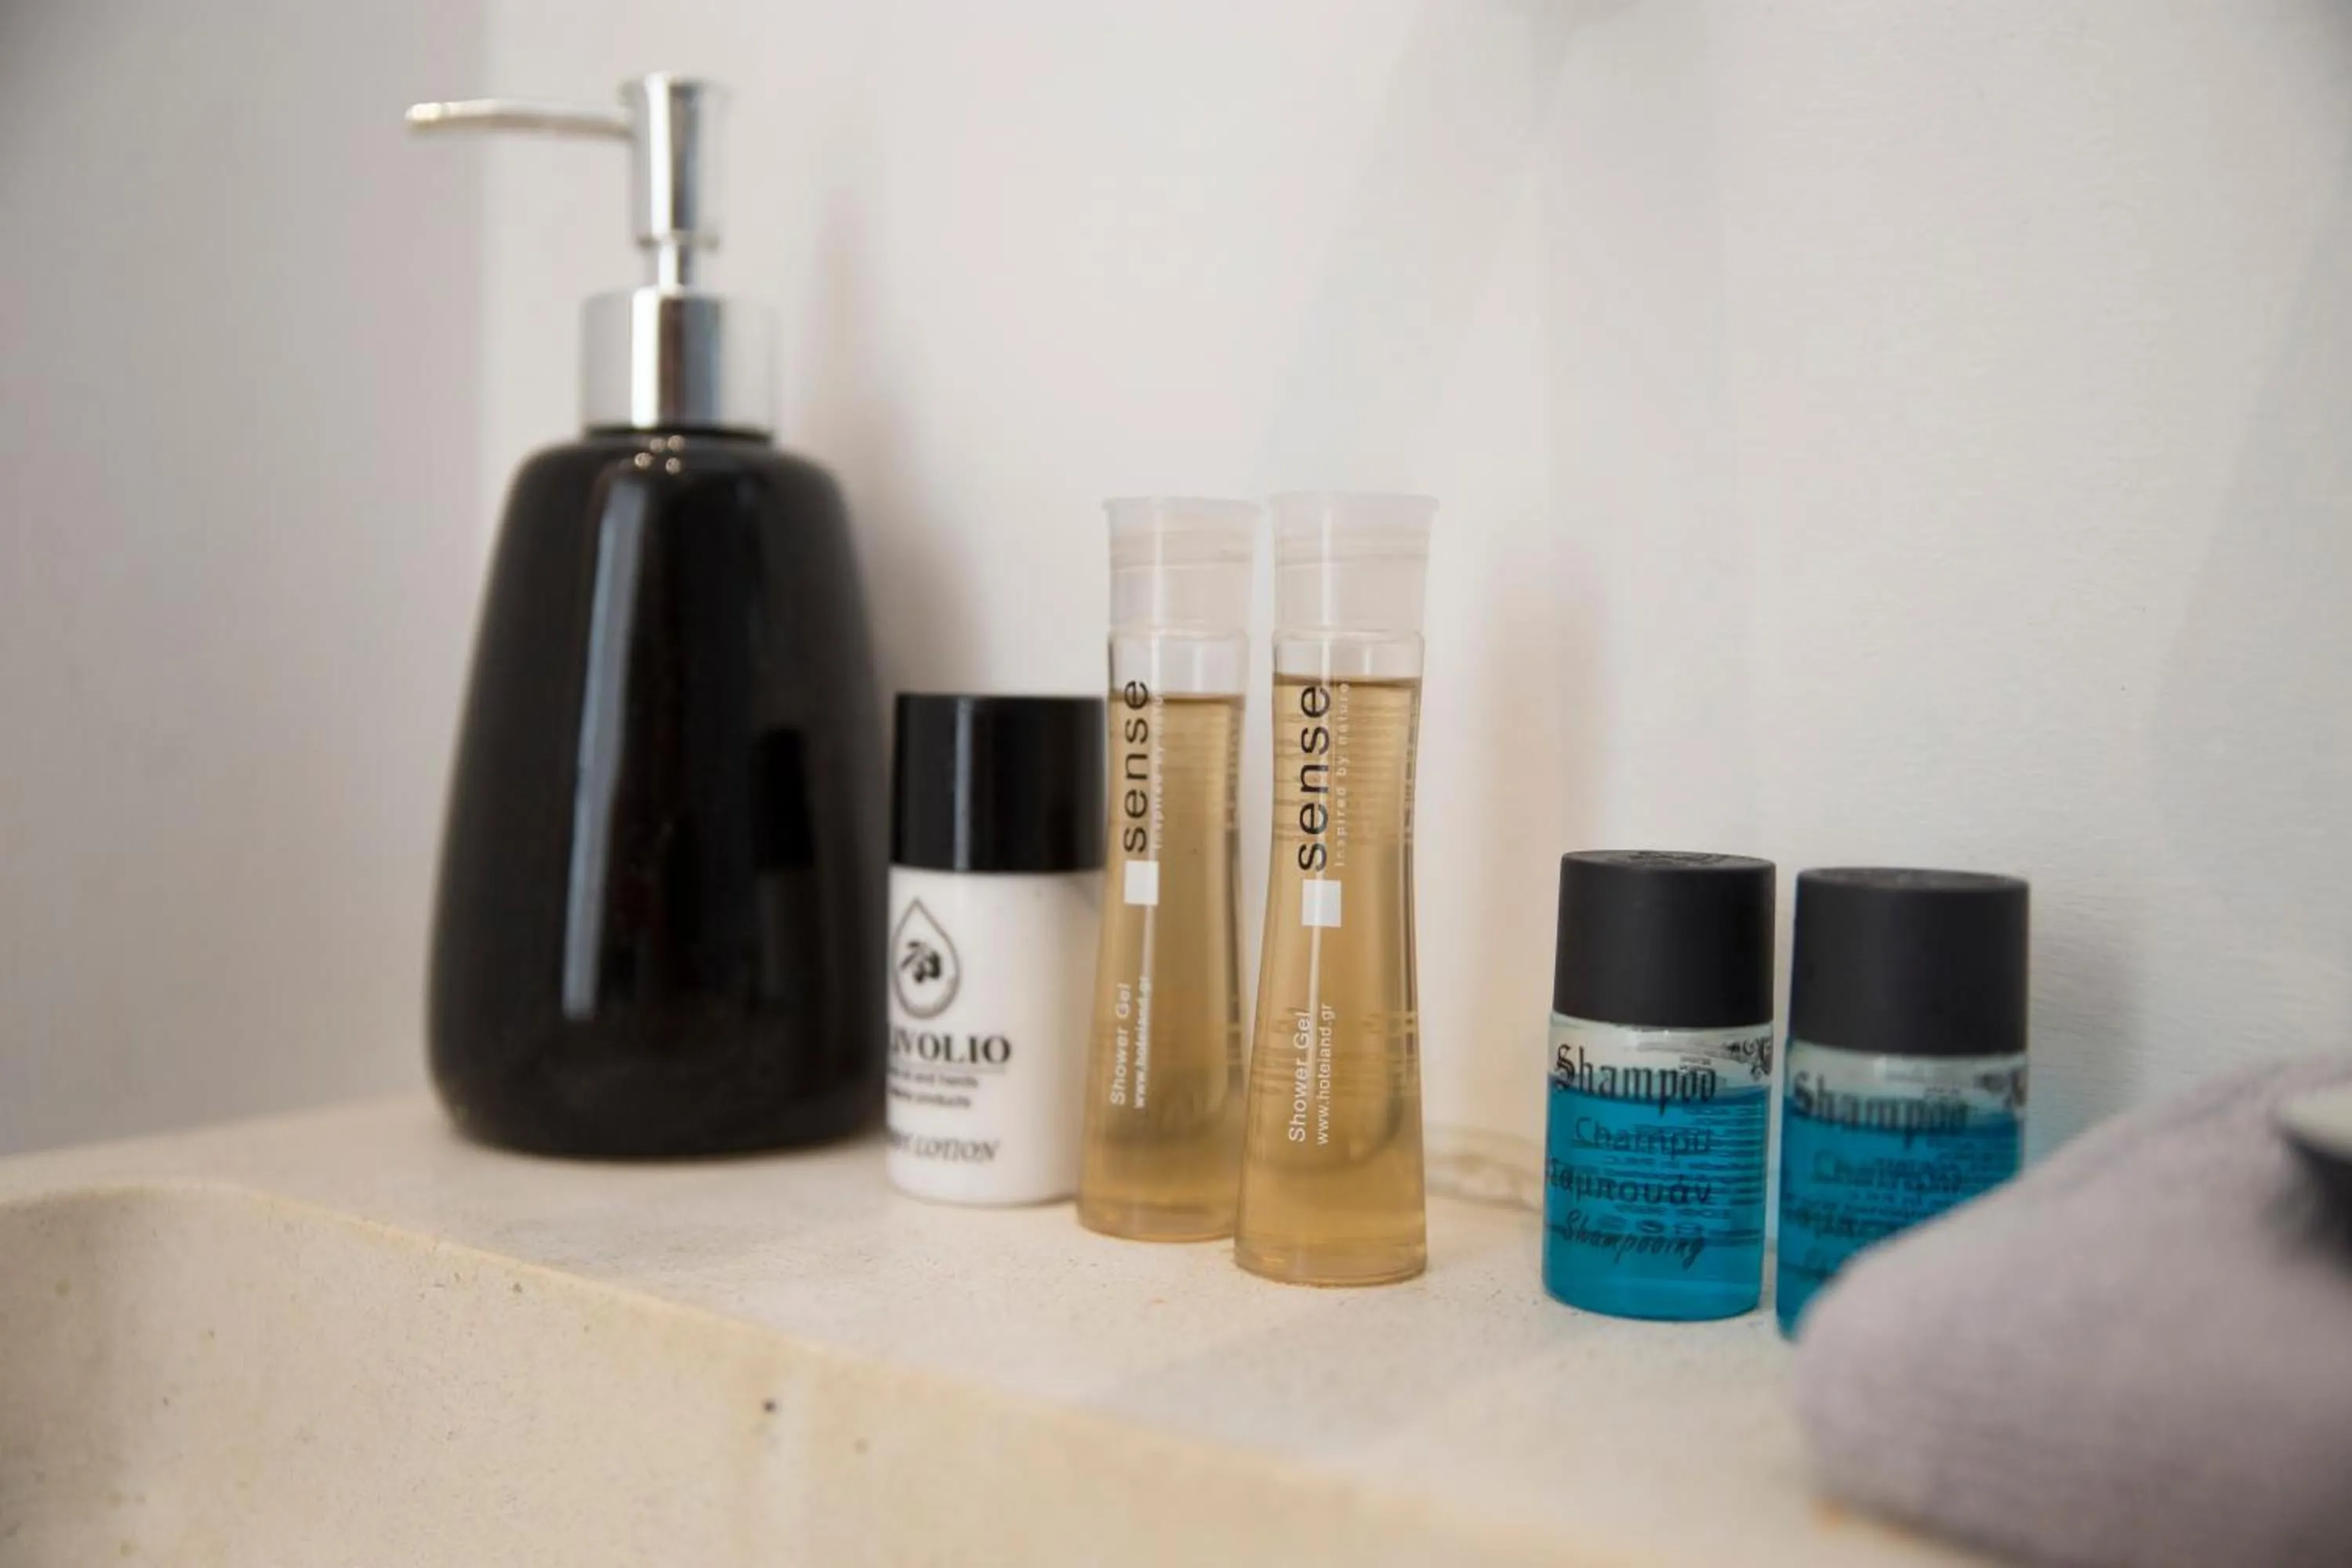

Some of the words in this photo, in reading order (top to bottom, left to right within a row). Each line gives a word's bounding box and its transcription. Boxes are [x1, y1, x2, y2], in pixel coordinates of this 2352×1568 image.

[1337, 683, 1350, 746] nature
[1123, 681, 1149, 854] sense
[1298, 685, 1331, 872] sense
[1335, 757, 1349, 777] by
[1115, 982, 1131, 1019] Gel
[1293, 1011, 1312, 1050] Gel
[1110, 1026, 1129, 1106] Shower
[1288, 1057, 1309, 1143] Shower
[1316, 1002, 1335, 1145] www.hoteland.gr
[1554, 1043, 1717, 1117] Shampoo
